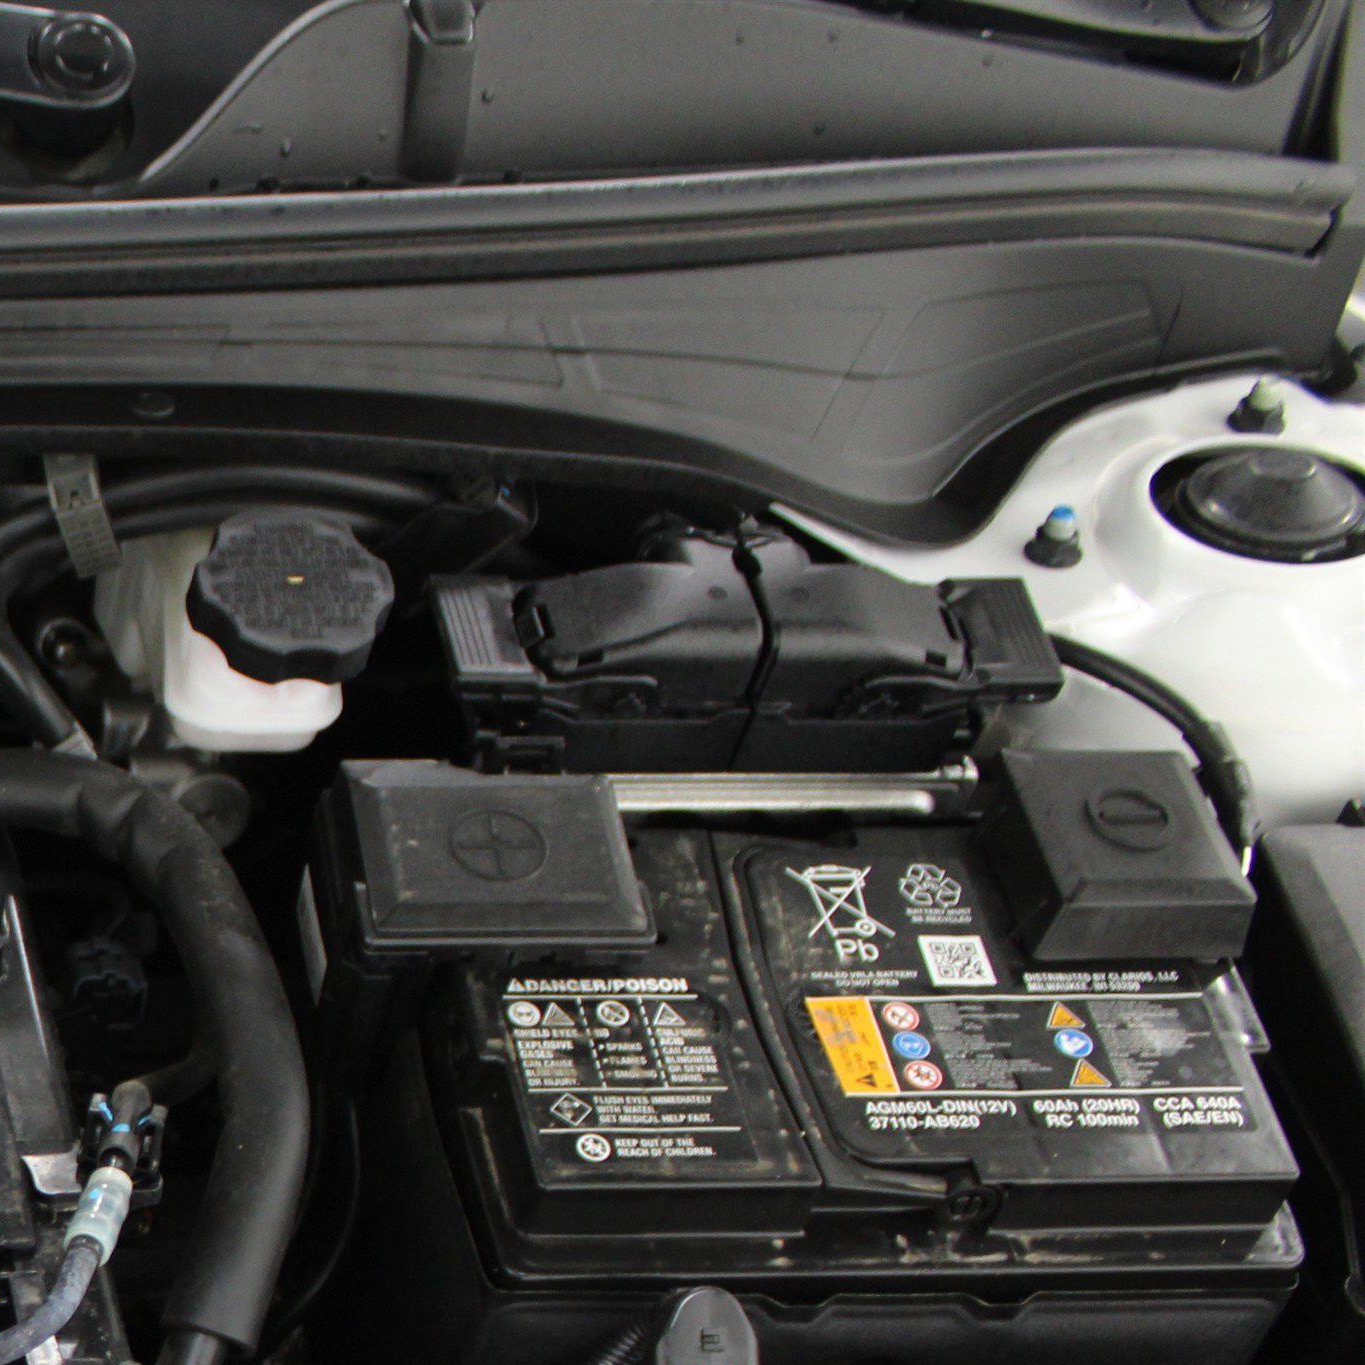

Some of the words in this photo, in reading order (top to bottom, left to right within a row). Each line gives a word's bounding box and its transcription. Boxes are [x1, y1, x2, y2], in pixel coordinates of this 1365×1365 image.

[906, 908, 944, 916] BATTERY
[835, 938, 880, 963] Pb
[811, 970, 848, 979] SEALED
[876, 970, 918, 979] BATTERY
[1023, 972, 1092, 983] DISTRIBUTED
[524, 977, 689, 993] DANGER/POISON
[872, 979, 900, 987] OPEN
[514, 1028, 550, 1038] SHIELD
[518, 1040, 574, 1050] EXPLOSIVE
[606, 1042, 643, 1052] SPARKS
[660, 1037, 685, 1047] ACID
[683, 1046, 713, 1055] CAUSE
[593, 1096, 623, 1105] FLUSH
[625, 1096, 649, 1105] EYES
[651, 1095, 712, 1104] IMMEDIATELY
[1153, 1096, 1193, 1112] CCA
[1196, 1096, 1242, 1111] 640A
[596, 1106, 621, 1114] WITH
[866, 1100, 1017, 1117] AGM60L-DIN(12V)
[1033, 1099, 1080, 1114] 60Ah
[1083, 1099, 1140, 1114] (20HR)
[600, 1114, 618, 1123] GET
[619, 1114, 660, 1123] MEDICAL
[662, 1114, 686, 1122] HELP
[688, 1114, 714, 1122] FAST.
[870, 1114, 981, 1129] 37110-AB620
[1046, 1113, 1073, 1128] RC
[1076, 1113, 1139, 1128] 100min
[1164, 1111, 1244, 1127] (SAE/EN)
[615, 1139, 639, 1148] KEEP
[640, 1139, 660, 1147] OUT
[661, 1139, 675, 1147] OF
[676, 1138, 695, 1146] THE
[617, 1148, 649, 1157] REACH
[651, 1148, 664, 1156] OF
[665, 1147, 716, 1156] CHILDREN.
